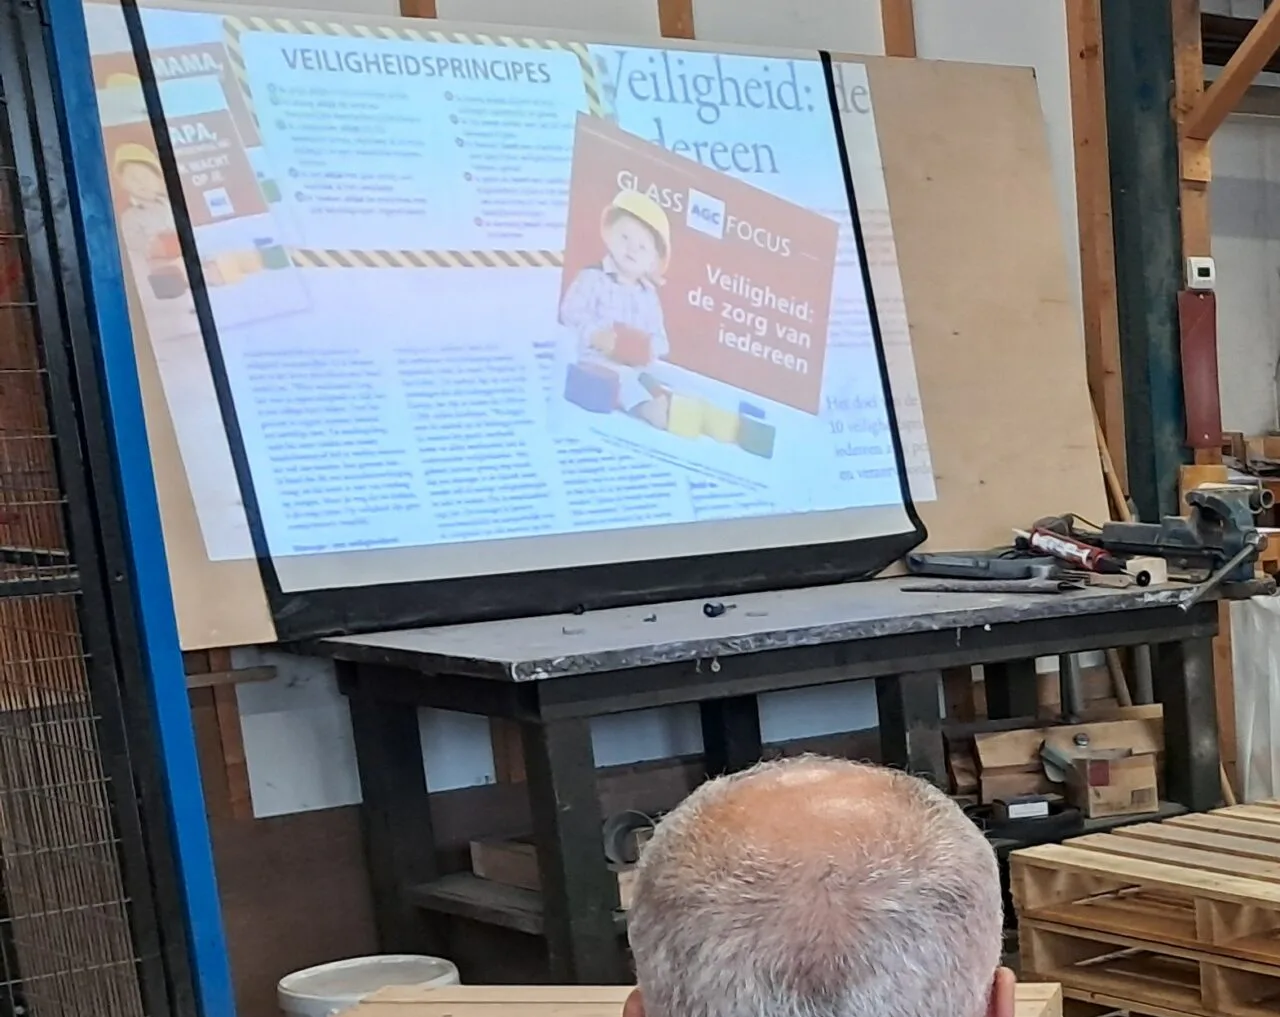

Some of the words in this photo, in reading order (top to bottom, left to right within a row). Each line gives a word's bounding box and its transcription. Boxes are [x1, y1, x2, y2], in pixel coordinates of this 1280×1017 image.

[281, 47, 552, 84] VEILIGHEIDSPRINCIPES
[608, 50, 815, 125] Veiligheid:
[690, 203, 721, 226] AGC
[725, 215, 792, 257] FOCUS
[687, 285, 716, 313] de
[720, 301, 769, 337] zorg
[774, 321, 812, 350] van
[705, 262, 815, 323] Veiligheid:
[718, 322, 809, 375] iedereen
